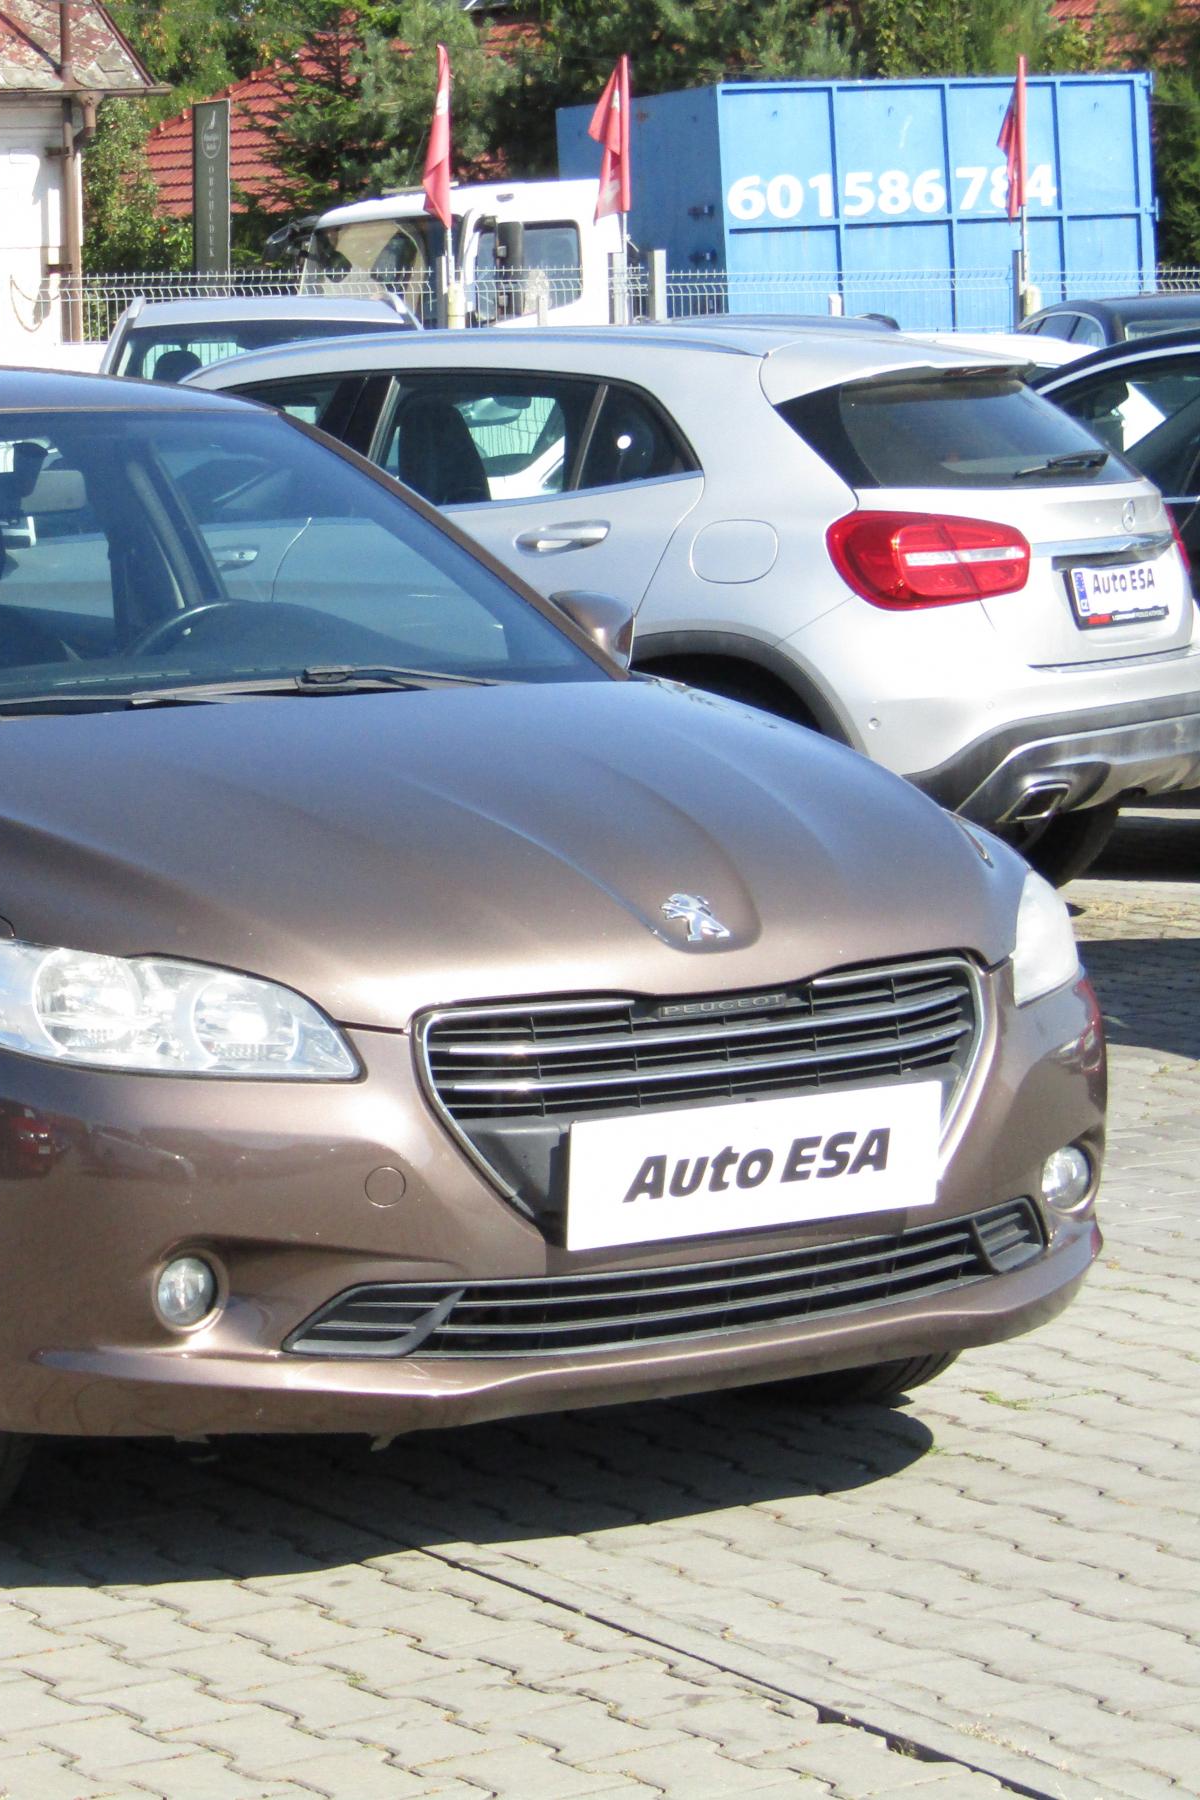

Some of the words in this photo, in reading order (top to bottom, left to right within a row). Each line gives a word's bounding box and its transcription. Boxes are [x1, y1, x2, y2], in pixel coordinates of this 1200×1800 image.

[727, 174, 834, 221] 601
[843, 168, 947, 217] 586
[1129, 567, 1155, 590] ESA
[663, 993, 786, 1016] PEUGEOT
[622, 1145, 775, 1204] Auto
[780, 1127, 892, 1184] ESA
